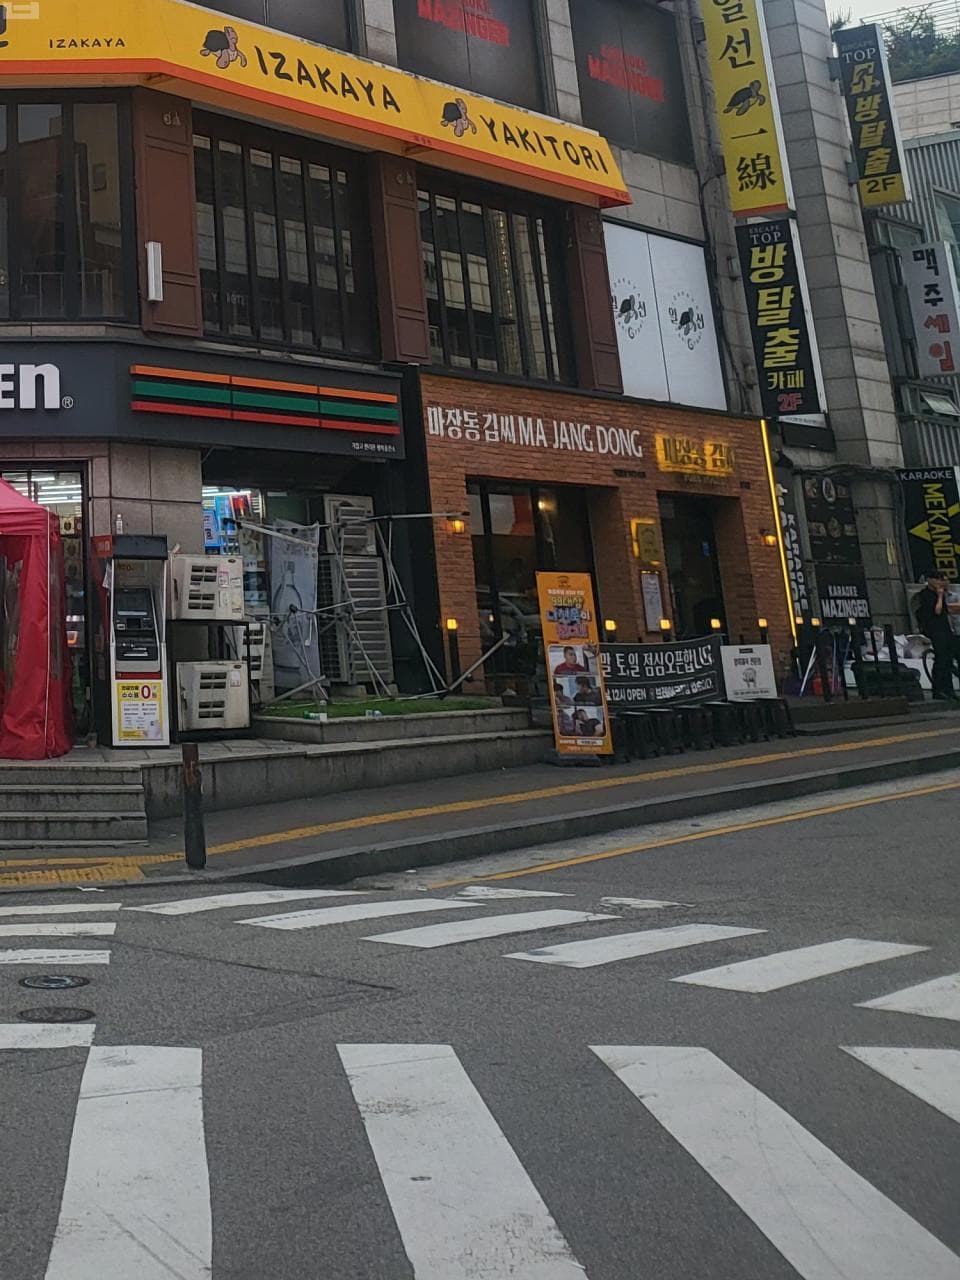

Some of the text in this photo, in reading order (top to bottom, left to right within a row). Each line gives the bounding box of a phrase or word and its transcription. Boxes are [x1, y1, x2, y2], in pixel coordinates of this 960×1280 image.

[49, 38, 126, 49] IZAKAYA
[842, 47, 876, 64] TOP
[254, 46, 401, 114] IZAKAYA
[854, 92, 892, 176] 방탈출
[481, 114, 610, 175] YAKITORI
[865, 176, 897, 194] 2F
[750, 232, 782, 245] TOP
[749, 243, 800, 369] 방탈출
[767, 369, 804, 391] 카페
[777, 392, 803, 412] 2F
[518, 414, 548, 448] MA
[552, 421, 592, 453] JANG
[597, 426, 643, 458] DONG
[900, 470, 953, 481] KARAOKE
[828, 584, 858, 597] KARAOKE
[821, 599, 870, 618] MAZINGER
[627, 688, 646, 701] OPEN
